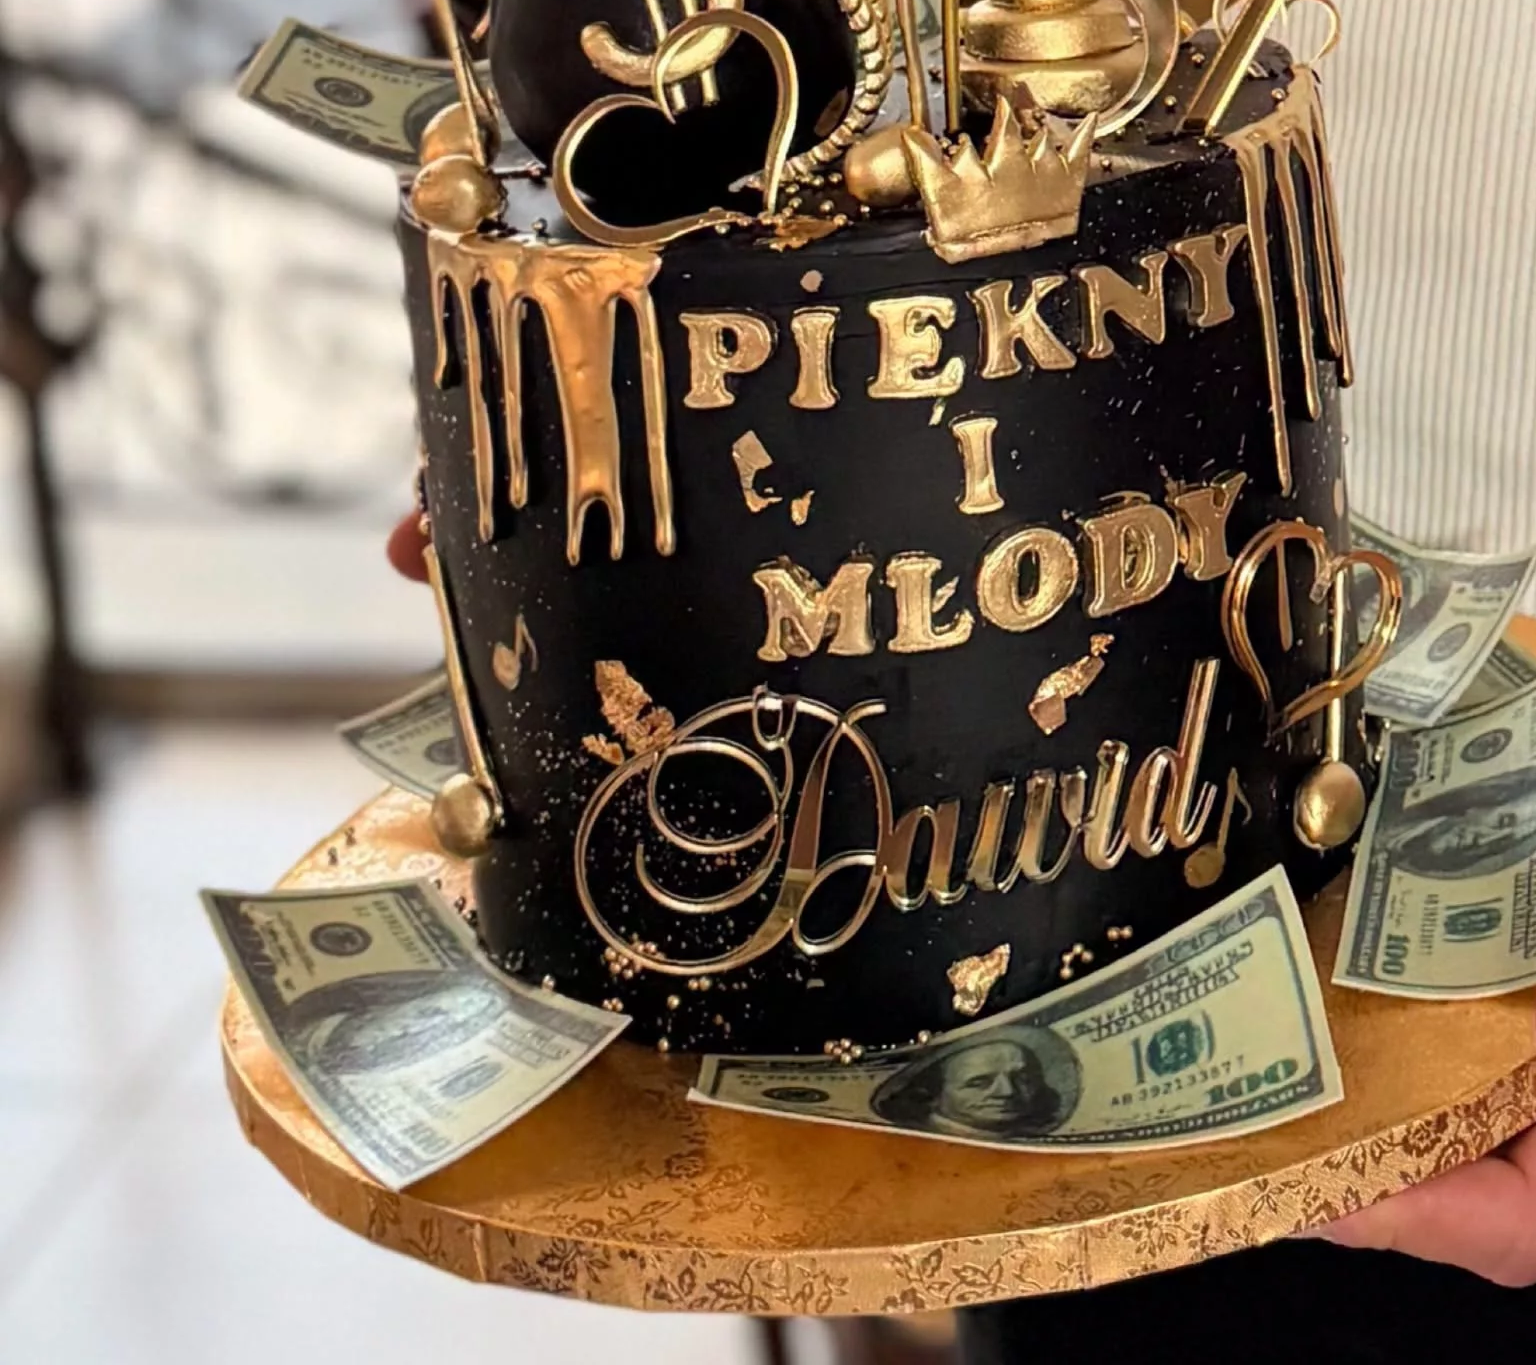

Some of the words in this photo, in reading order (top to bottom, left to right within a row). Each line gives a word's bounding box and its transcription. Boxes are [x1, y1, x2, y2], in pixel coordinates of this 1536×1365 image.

[949, 411, 1006, 517] I
[752, 472, 1247, 663] MŁODY
[574, 657, 1221, 977] Dawid
[1203, 1057, 1300, 1107] 100
